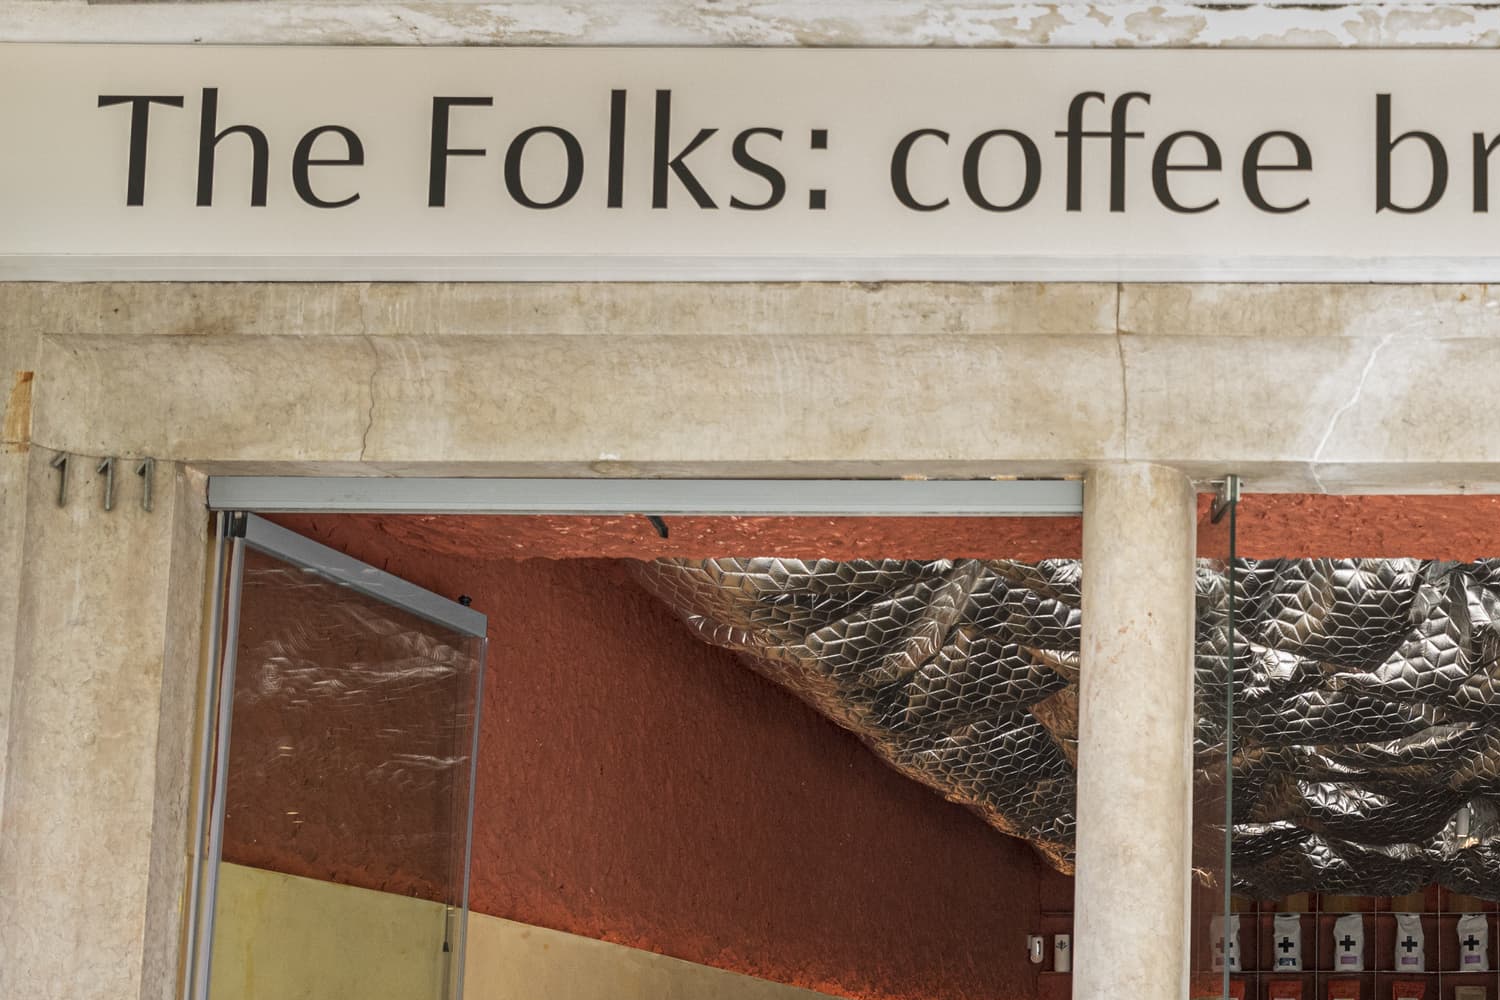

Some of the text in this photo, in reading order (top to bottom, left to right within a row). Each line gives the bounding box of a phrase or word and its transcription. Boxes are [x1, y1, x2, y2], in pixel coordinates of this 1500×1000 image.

[98, 88, 364, 208] The
[429, 89, 827, 211] Folks:
[891, 91, 1312, 213] coffee
[51, 451, 154, 512] 111
